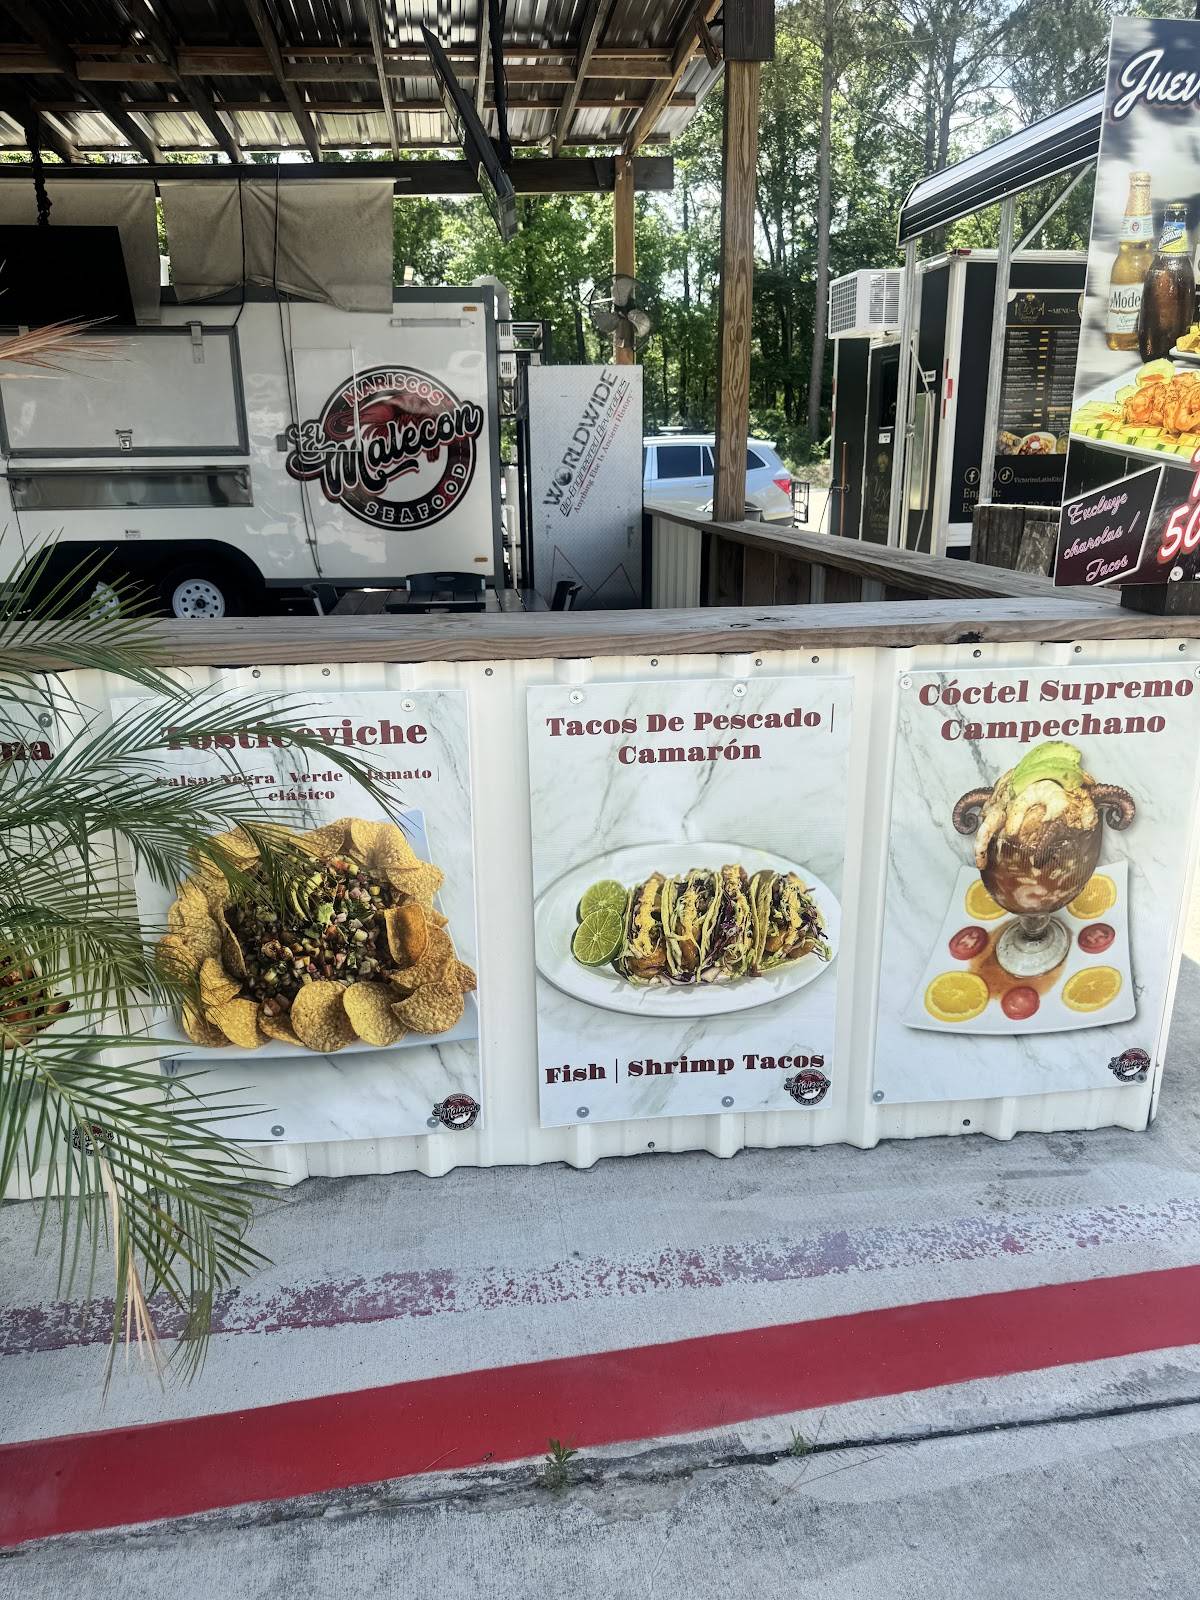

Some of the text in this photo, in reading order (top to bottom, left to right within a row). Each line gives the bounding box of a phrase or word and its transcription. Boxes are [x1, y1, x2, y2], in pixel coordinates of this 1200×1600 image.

[1110, 291, 1141, 309] Mode
[342, 373, 444, 407] MARISCOS
[289, 404, 482, 496] Malecon
[542, 369, 618, 505] WORLDWIDE
[574, 479, 594, 514] Anything
[603, 422, 619, 453] Ancient
[365, 463, 468, 523] SEAFOOD
[1064, 525, 1123, 559] charolas
[1085, 554, 1128, 582] Tacos
[918, 678, 1194, 706] Cóctel Supremo
[546, 716, 637, 737] Tacos
[646, 713, 685, 733] De
[693, 707, 822, 731] Pescado
[941, 713, 1166, 743] Campechano
[618, 738, 762, 765] Camarón
[289, 770, 344, 783] Verde
[267, 786, 335, 802] clásico
[544, 1063, 607, 1084] Fish
[627, 1056, 735, 1078] Shrimp
[742, 1053, 825, 1070] Tacos
